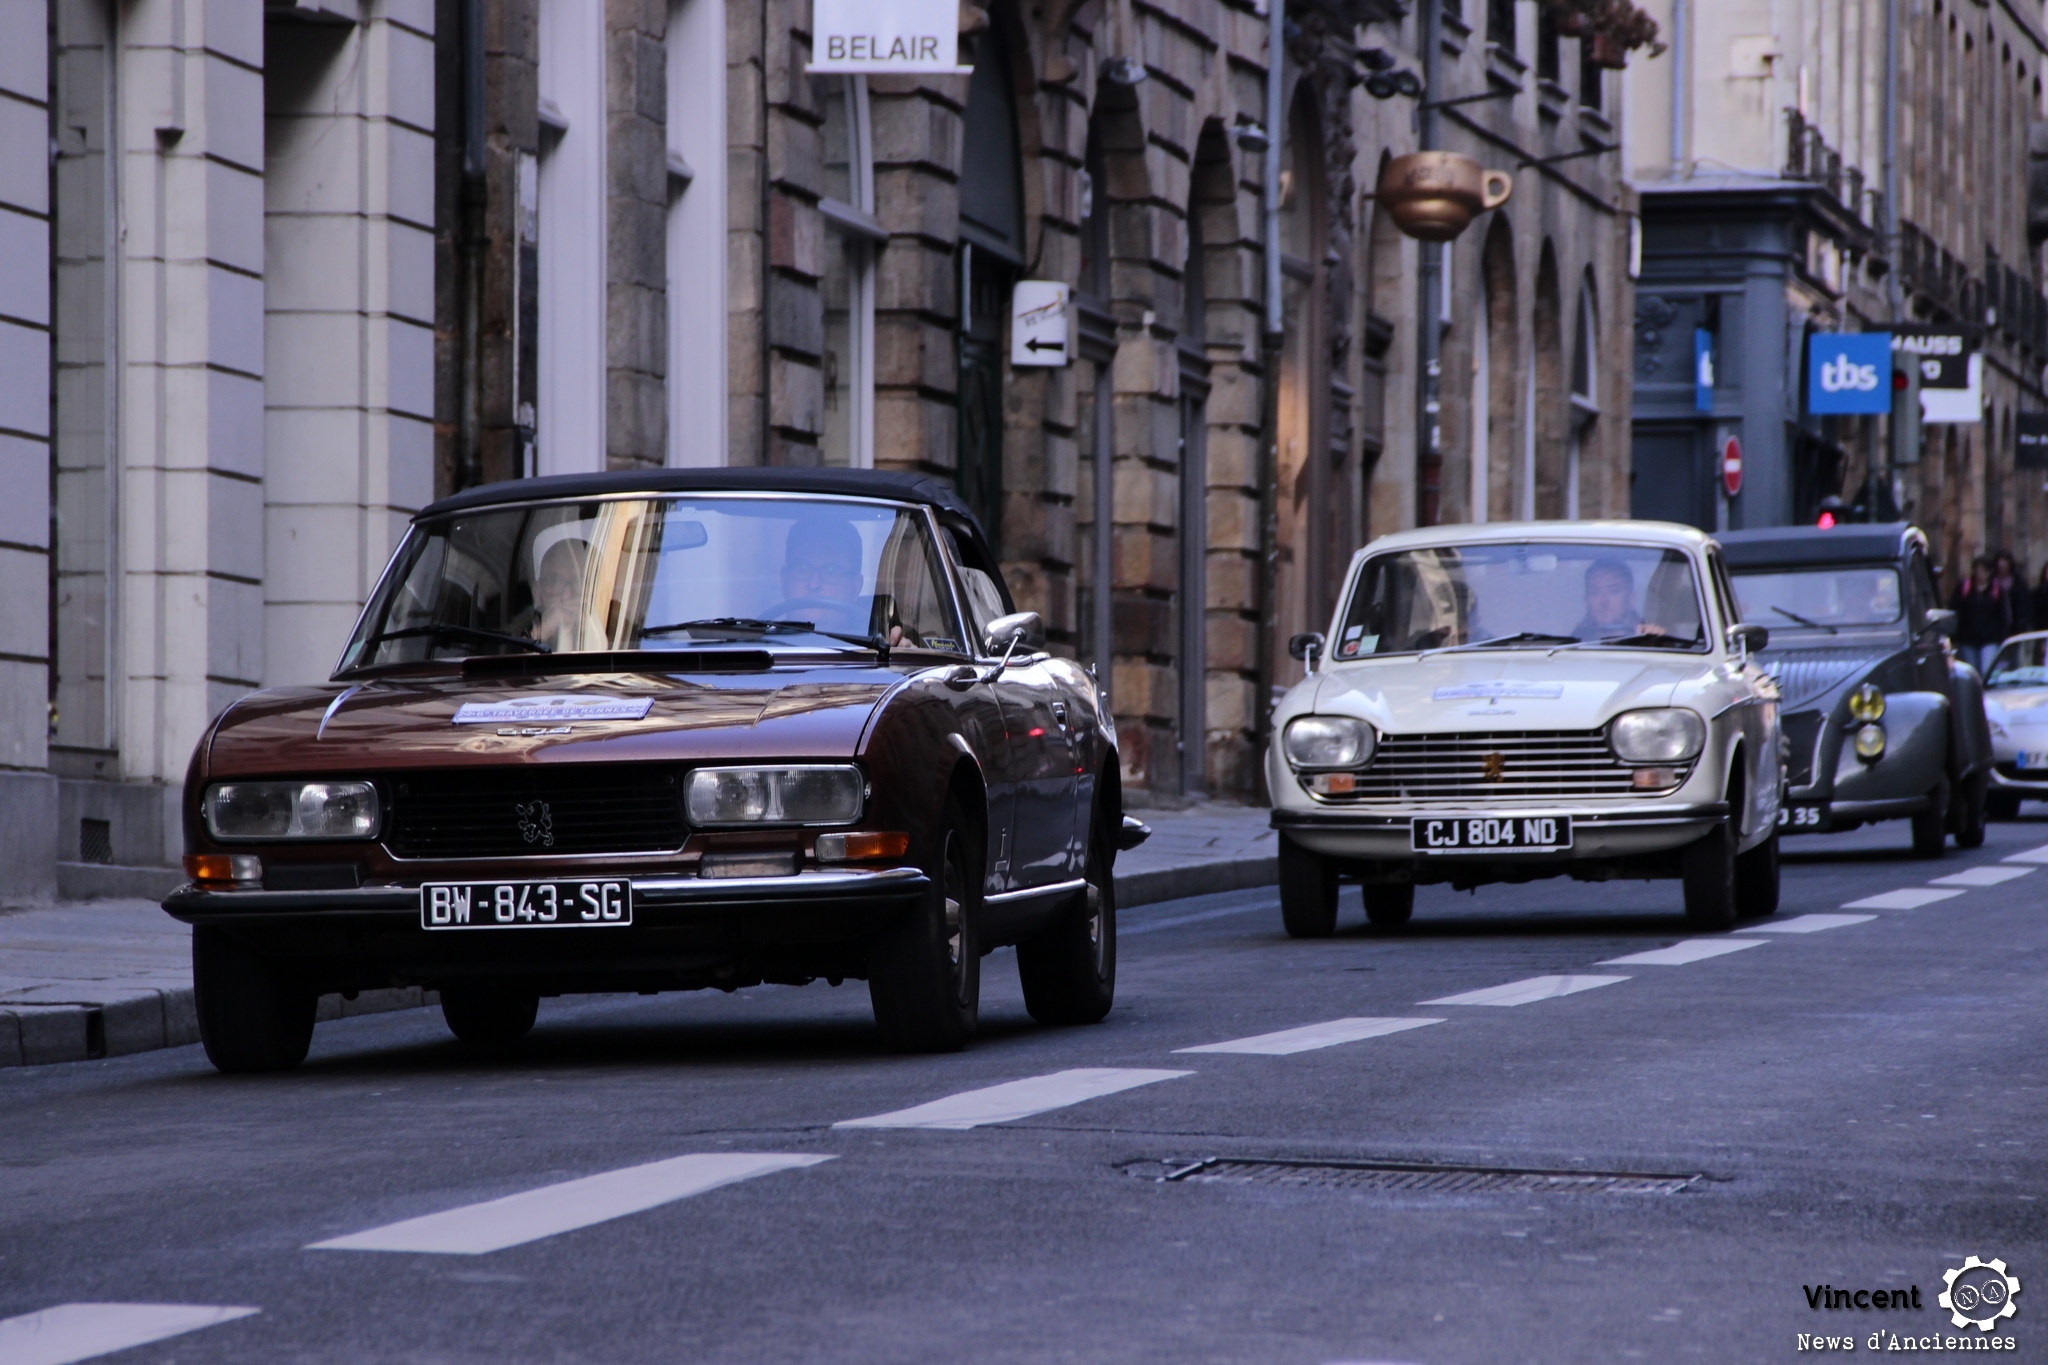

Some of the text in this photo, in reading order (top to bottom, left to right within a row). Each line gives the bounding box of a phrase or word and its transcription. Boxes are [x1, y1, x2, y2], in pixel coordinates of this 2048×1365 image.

[828, 36, 938, 60] BELAIR
[1821, 353, 1878, 391] tbs
[1794, 807, 1820, 825] 35
[1427, 821, 1460, 846] CJ
[1468, 819, 1516, 845] 804
[430, 883, 622, 924] BW-843-SG
